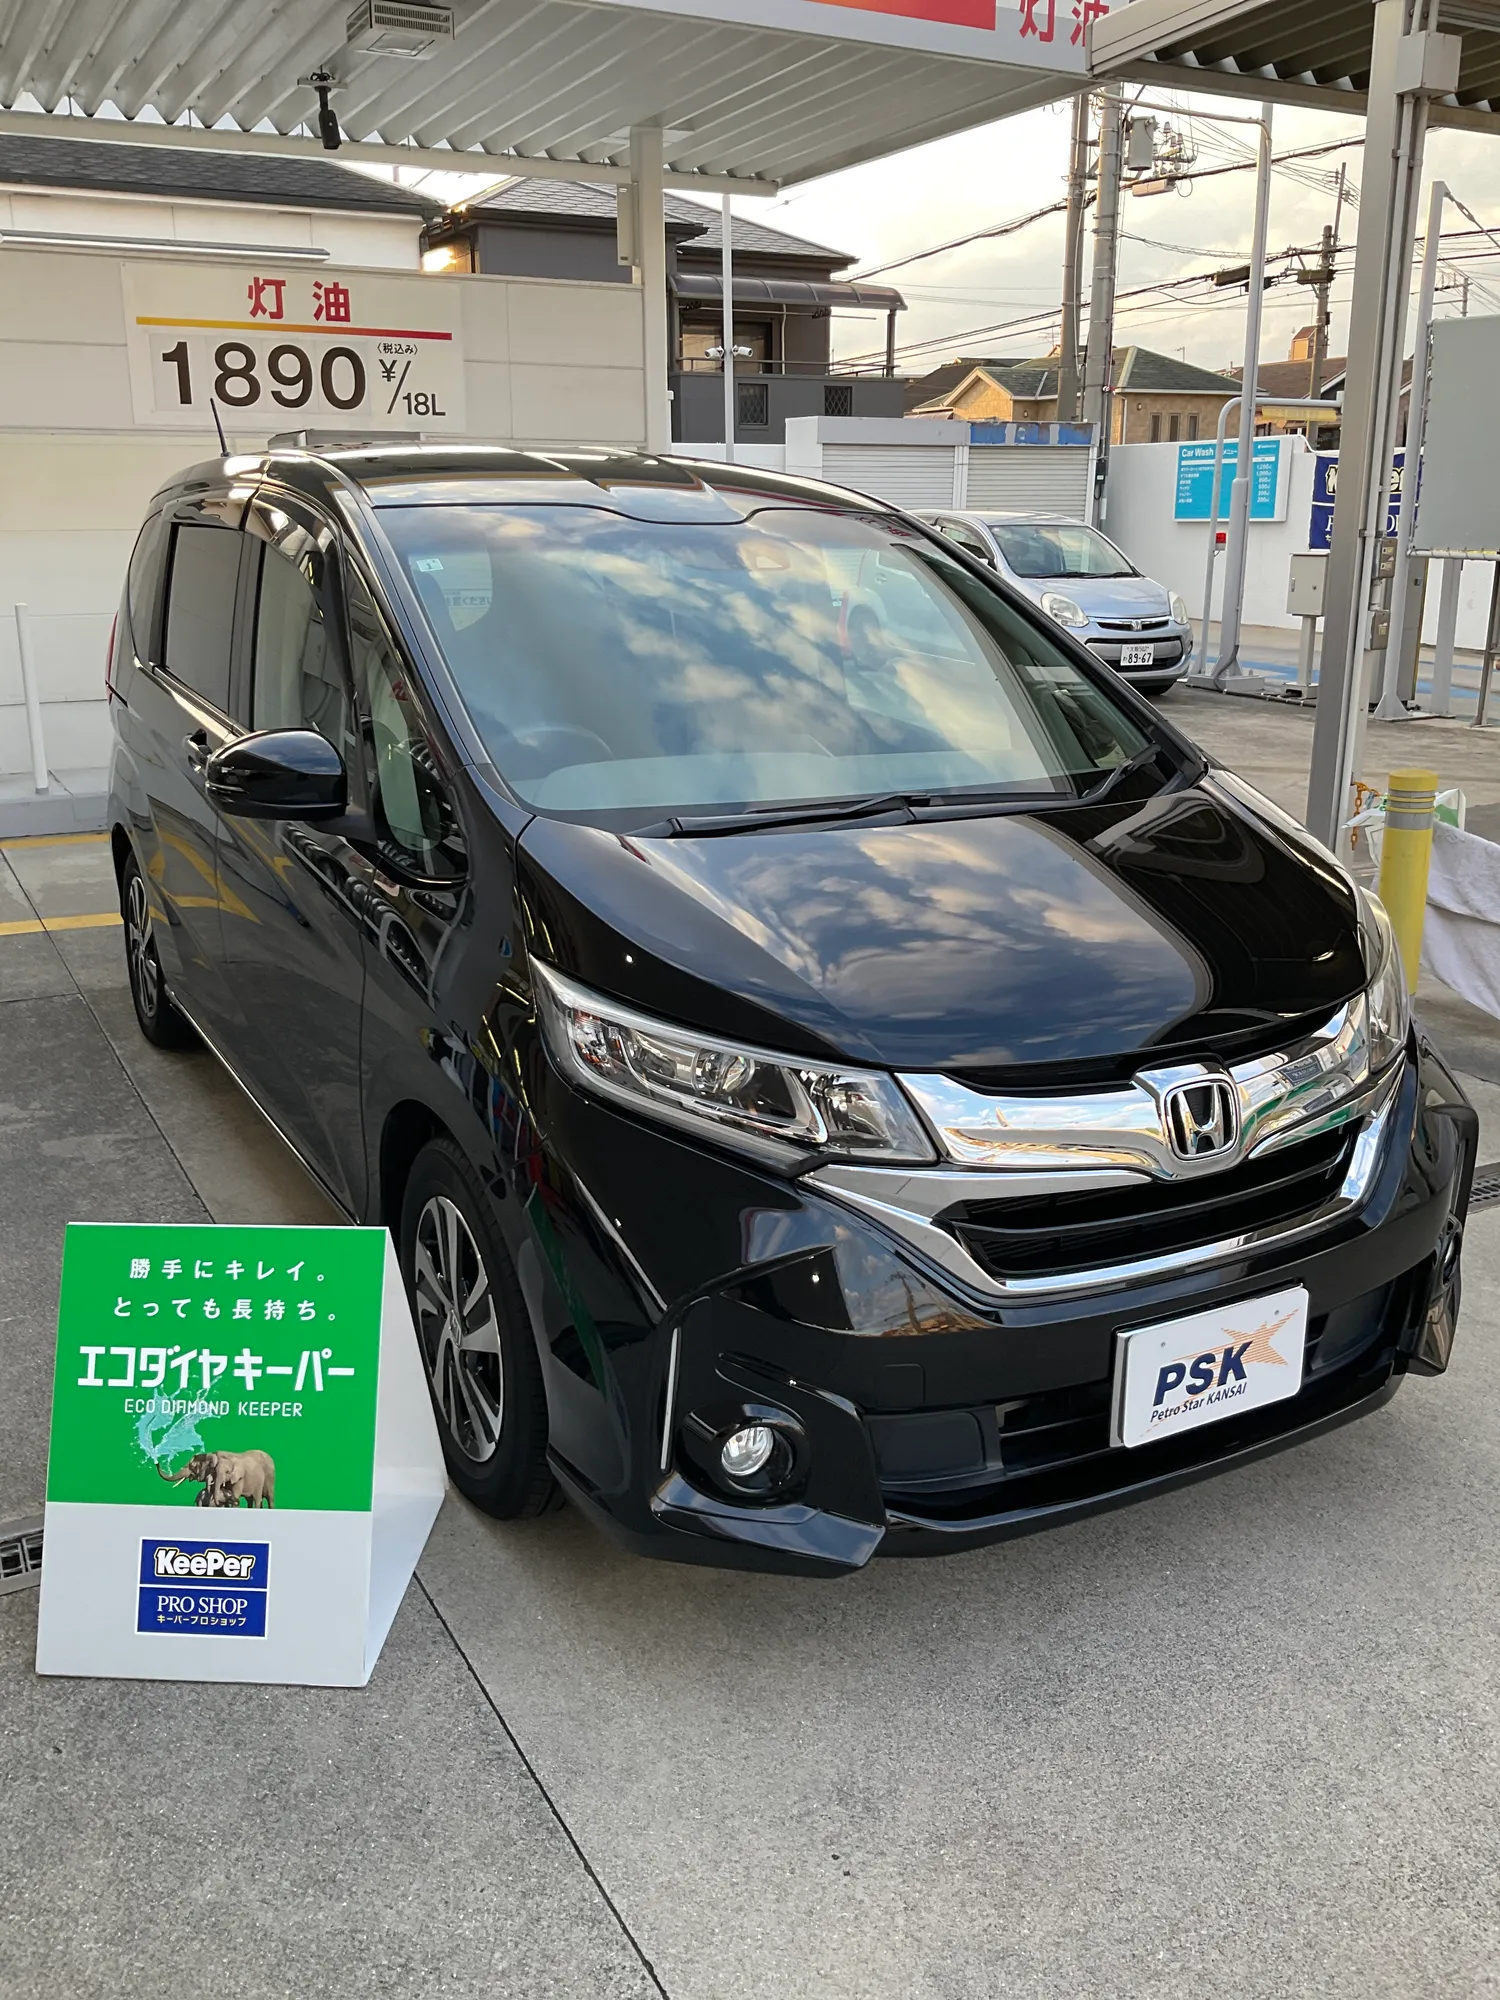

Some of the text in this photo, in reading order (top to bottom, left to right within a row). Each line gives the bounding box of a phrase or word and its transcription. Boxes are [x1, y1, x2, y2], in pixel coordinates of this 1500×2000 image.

[248, 276, 351, 322] 灯油
[162, 341, 366, 410] 1890
[1182, 449, 1194, 457] Car
[1195, 447, 1214, 456] Wash
[1128, 653, 1152, 663] 89-67
[129, 1258, 325, 1283] 勝手にキレイ。
[113, 1297, 336, 1321] とっても長持ち。
[77, 1345, 355, 1392] エコダイヤキーパー
[1153, 1340, 1253, 1407] PSK
[124, 1399, 303, 1417] ECO DIAMOND KEEPER
[1150, 1383, 1247, 1423] Petro Star KANSAI
[154, 1547, 256, 1580] KeePer
[157, 1595, 248, 1615] PRO SHOP
